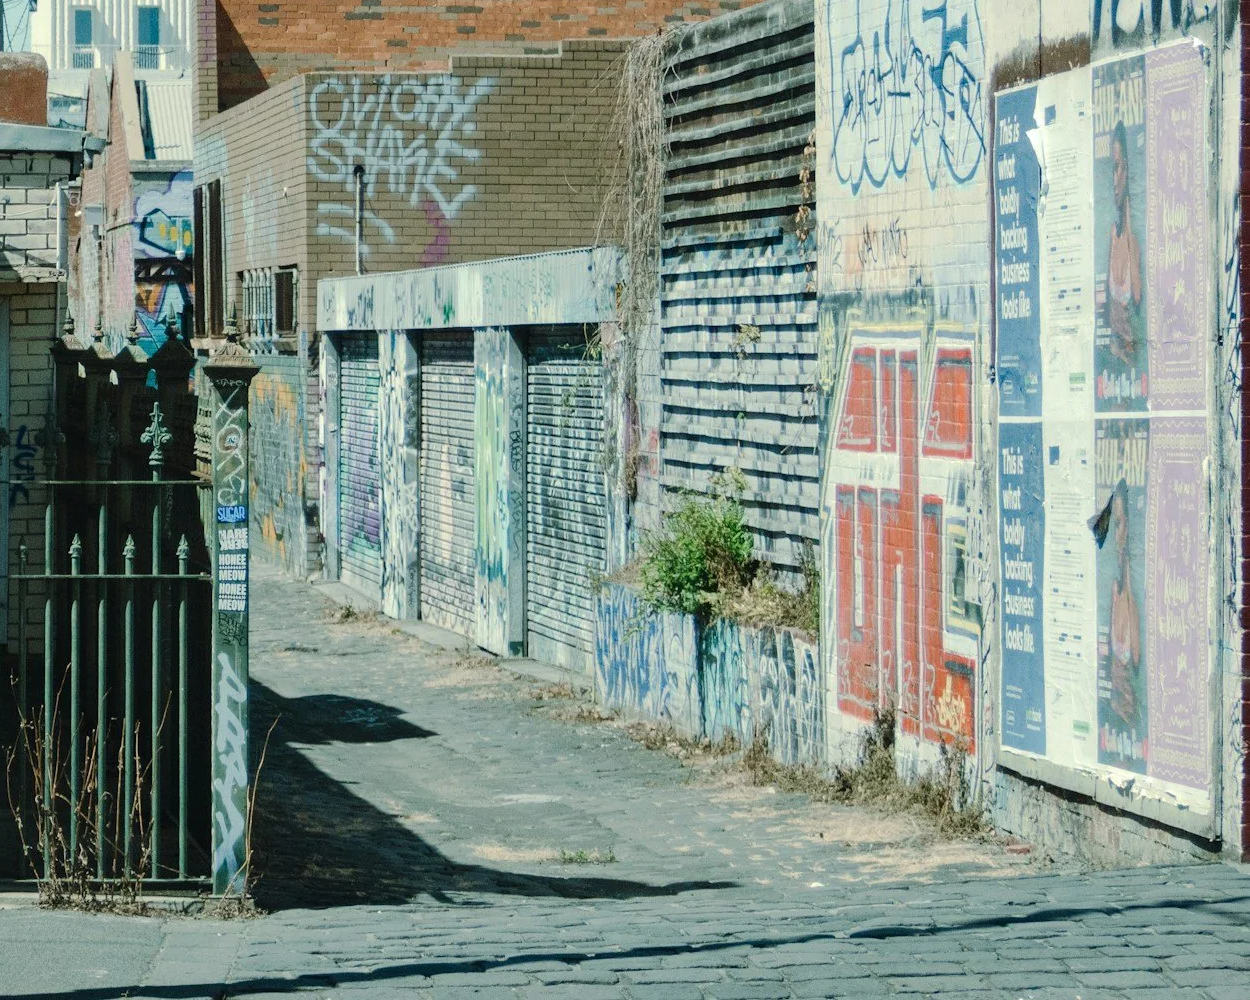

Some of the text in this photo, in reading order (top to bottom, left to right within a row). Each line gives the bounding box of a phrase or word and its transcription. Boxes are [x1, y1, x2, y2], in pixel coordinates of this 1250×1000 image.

[1000, 114, 1020, 146] This is
[998, 153, 1016, 181] what
[999, 186, 1019, 221] boldly
[1000, 221, 1028, 254] backing
[1001, 256, 1030, 285] business
[1001, 292, 1019, 320] looks
[1002, 446, 1024, 475] This is
[1003, 483, 1021, 510] what
[217, 505, 245, 521] SUGAR
[1004, 517, 1025, 552] boldly
[219, 553, 247, 565] HONEE
[1005, 552, 1033, 588] backing
[219, 570, 247, 580] MEOW
[219, 583, 247, 595] HONEE
[219, 599, 246, 611] MEOW
[1005, 587, 1034, 617] business
[1005, 621, 1024, 651] looks
